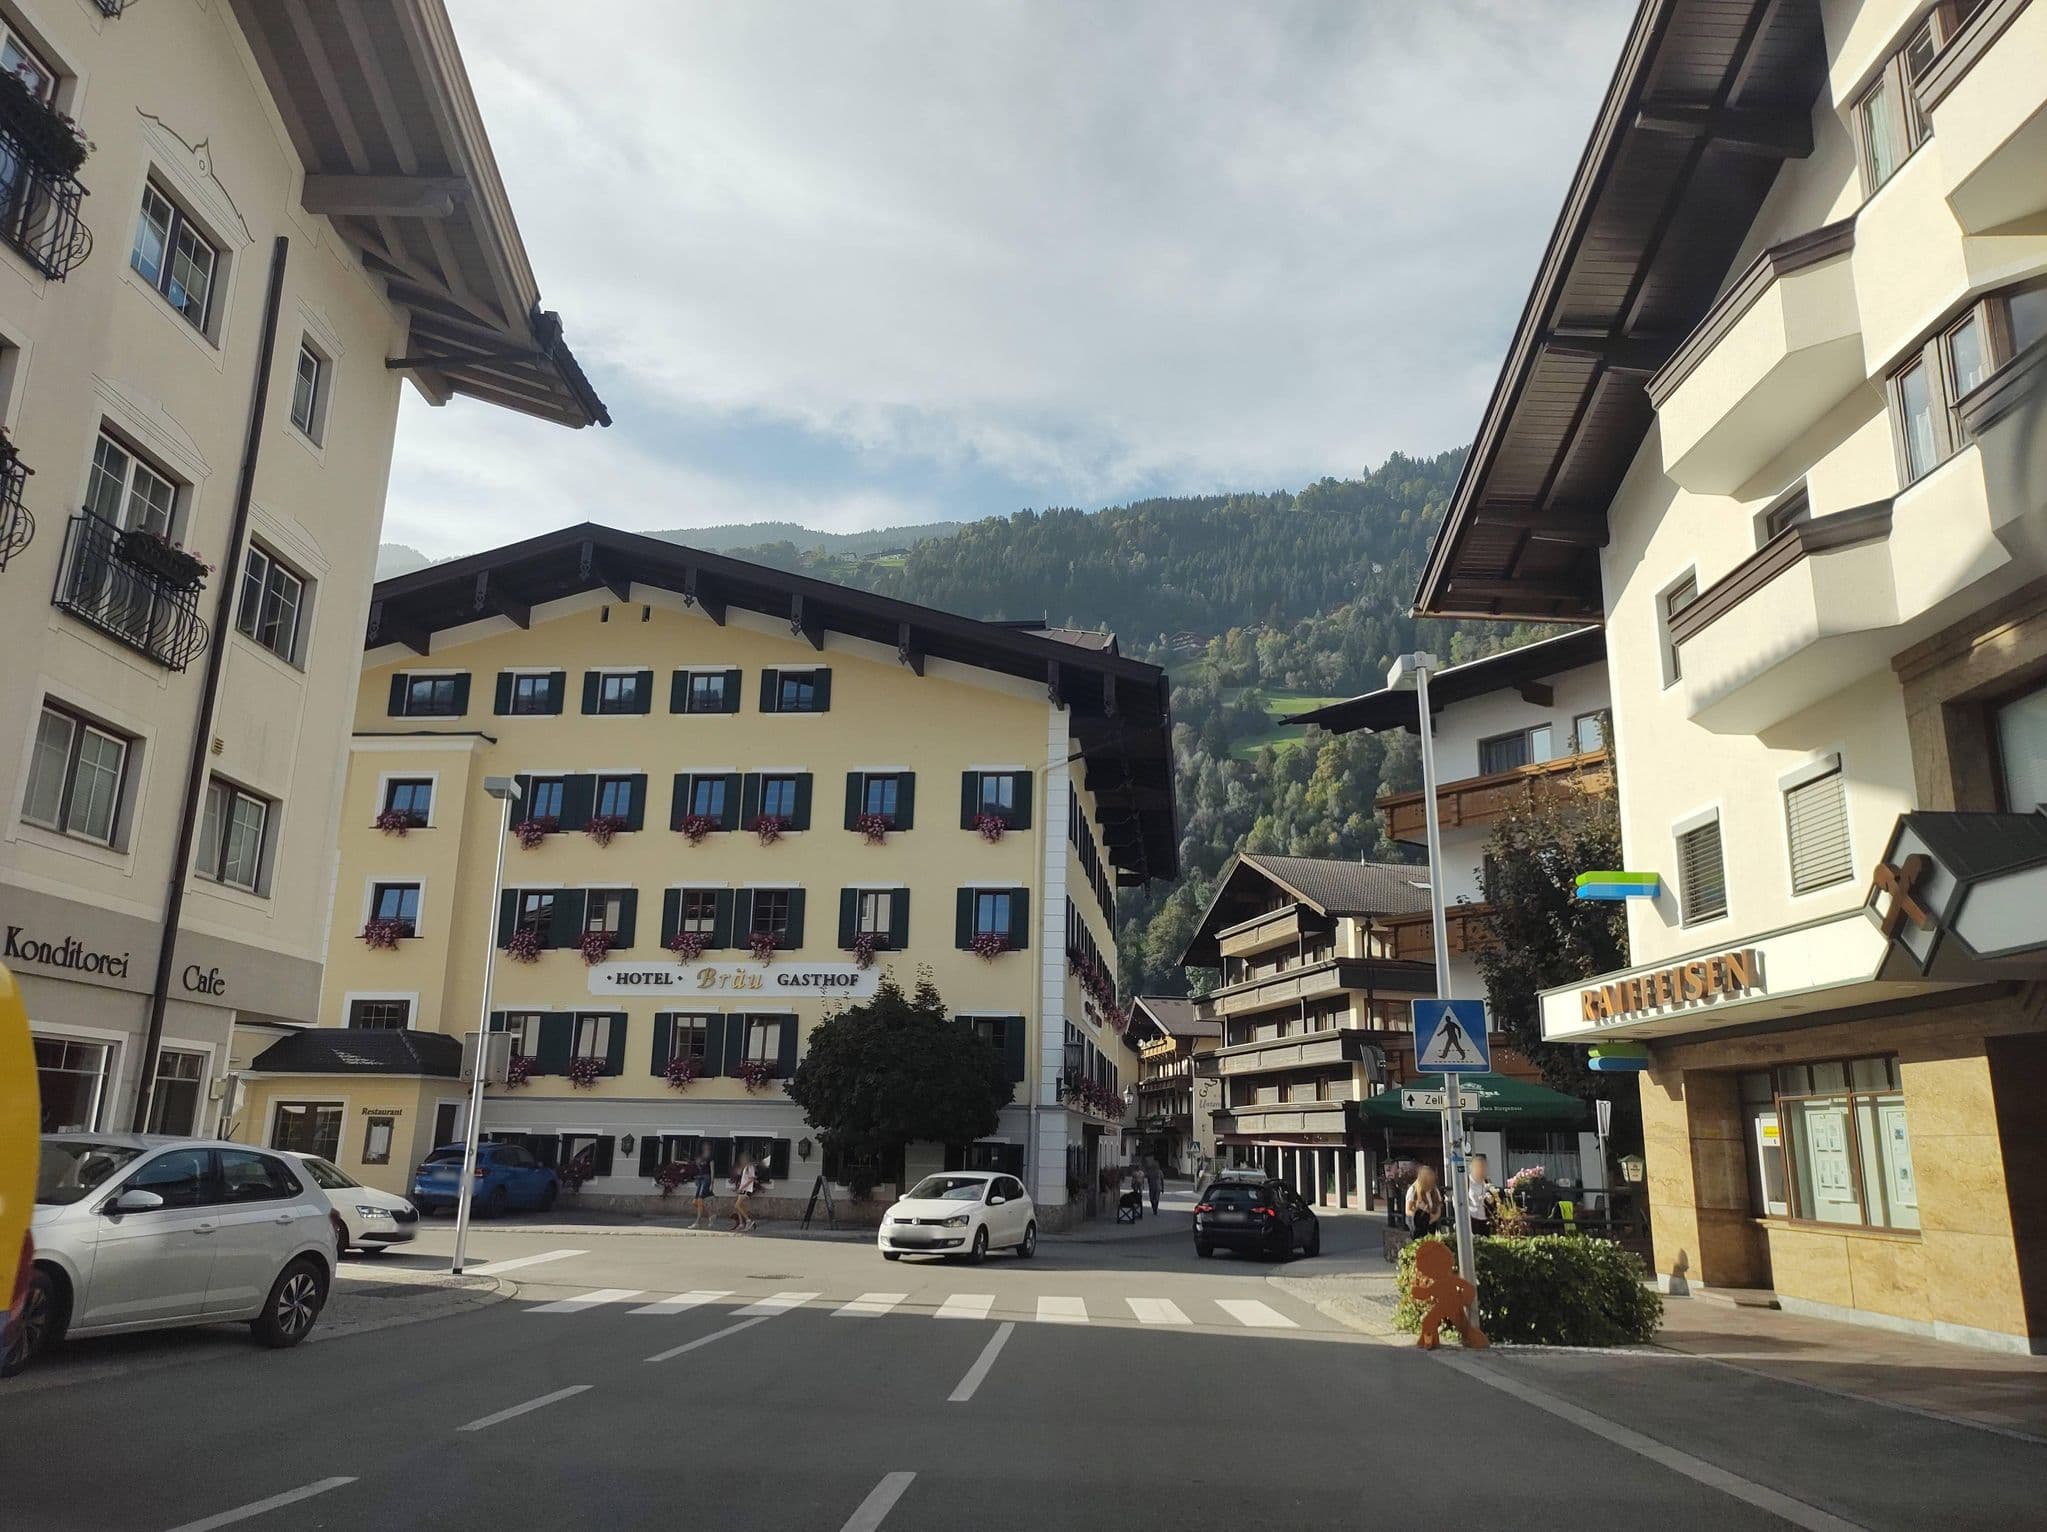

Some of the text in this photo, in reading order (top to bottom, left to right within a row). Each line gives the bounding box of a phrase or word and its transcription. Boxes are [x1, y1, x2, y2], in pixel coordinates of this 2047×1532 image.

[4, 925, 130, 978] Konditorei
[183, 964, 226, 996] Cafe
[616, 967, 859, 989] HOTEL Bräu GASTHOF
[1581, 949, 1758, 1021] RAIFFEISEN
[361, 1107, 403, 1116] Restaurant
[1424, 1094, 1466, 1108] Zellg
